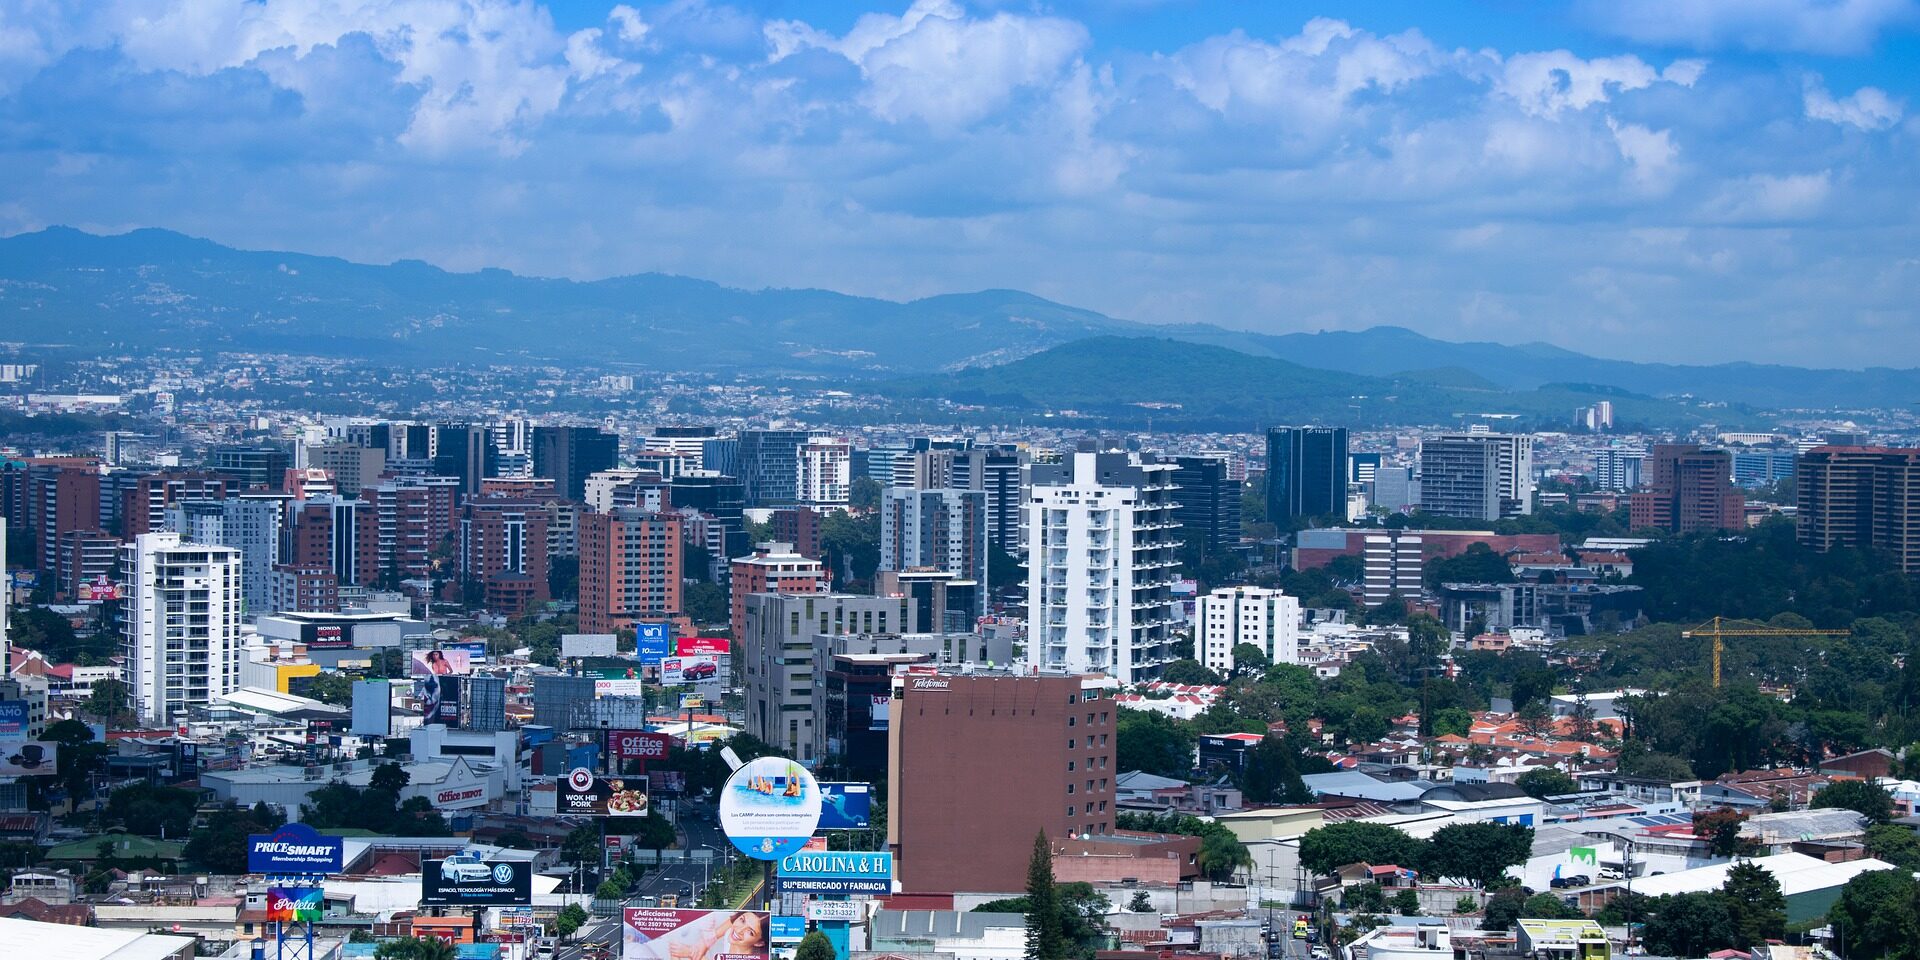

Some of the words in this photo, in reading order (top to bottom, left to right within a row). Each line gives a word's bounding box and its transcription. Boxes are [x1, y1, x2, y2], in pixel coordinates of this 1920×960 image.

[622, 737, 663, 748] Office
[437, 790, 460, 803] Office
[461, 789, 483, 799] DEPOT
[782, 855, 856, 872] CAROLINA
[858, 857, 870, 873] &
[873, 857, 887, 873] H.
[782, 881, 842, 890] SUPERMERCADO
[849, 882, 886, 890] FARMACIA
[273, 898, 317, 910] Paleta
